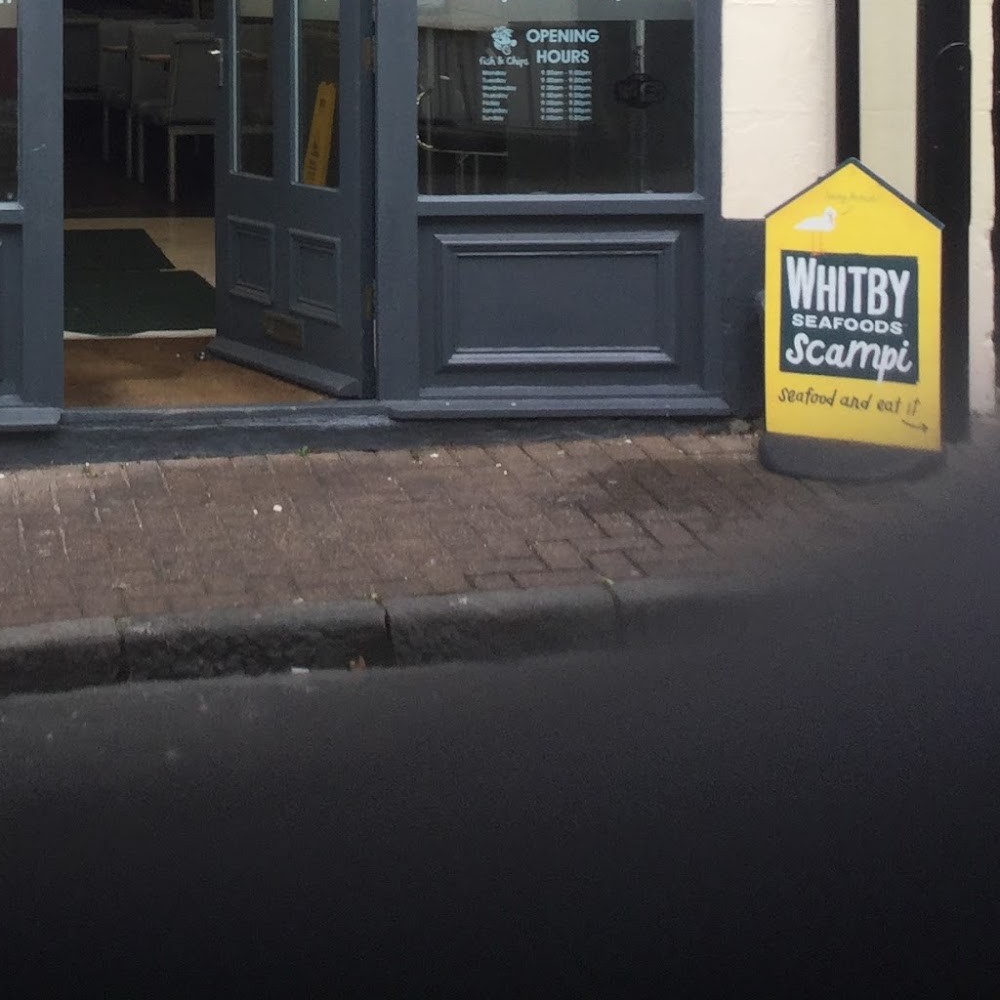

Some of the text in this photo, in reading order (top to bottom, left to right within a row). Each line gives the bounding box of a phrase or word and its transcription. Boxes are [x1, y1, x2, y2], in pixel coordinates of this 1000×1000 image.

[526, 28, 600, 43] OPENING
[536, 49, 590, 64] HOURS
[786, 256, 910, 318] WHITBY
[792, 314, 903, 335] SEAFOODS
[785, 332, 912, 384] Scampi
[840, 394, 873, 410] and
[877, 397, 901, 413] eat
